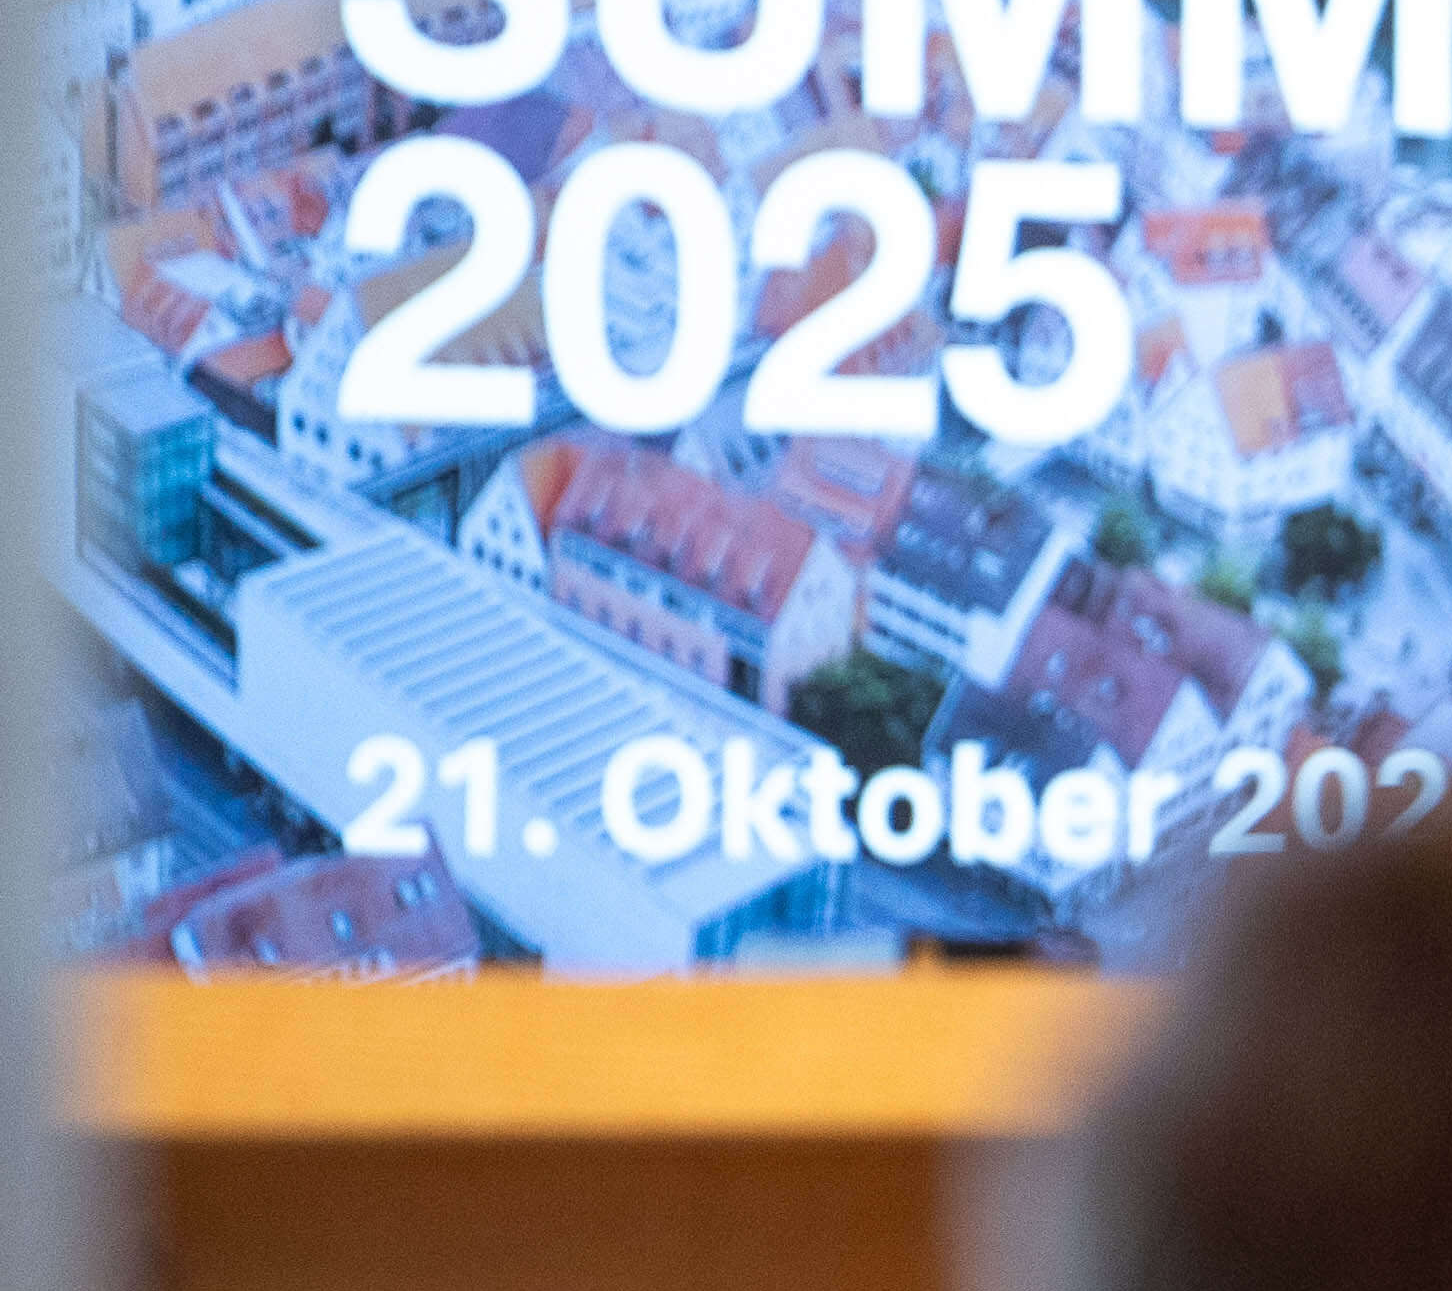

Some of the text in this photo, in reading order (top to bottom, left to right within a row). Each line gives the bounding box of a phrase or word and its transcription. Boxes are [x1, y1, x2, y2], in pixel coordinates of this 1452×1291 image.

[337, 135, 1135, 447] 2025
[343, 734, 559, 858] 21.
[600, 734, 1177, 864] Oktober
